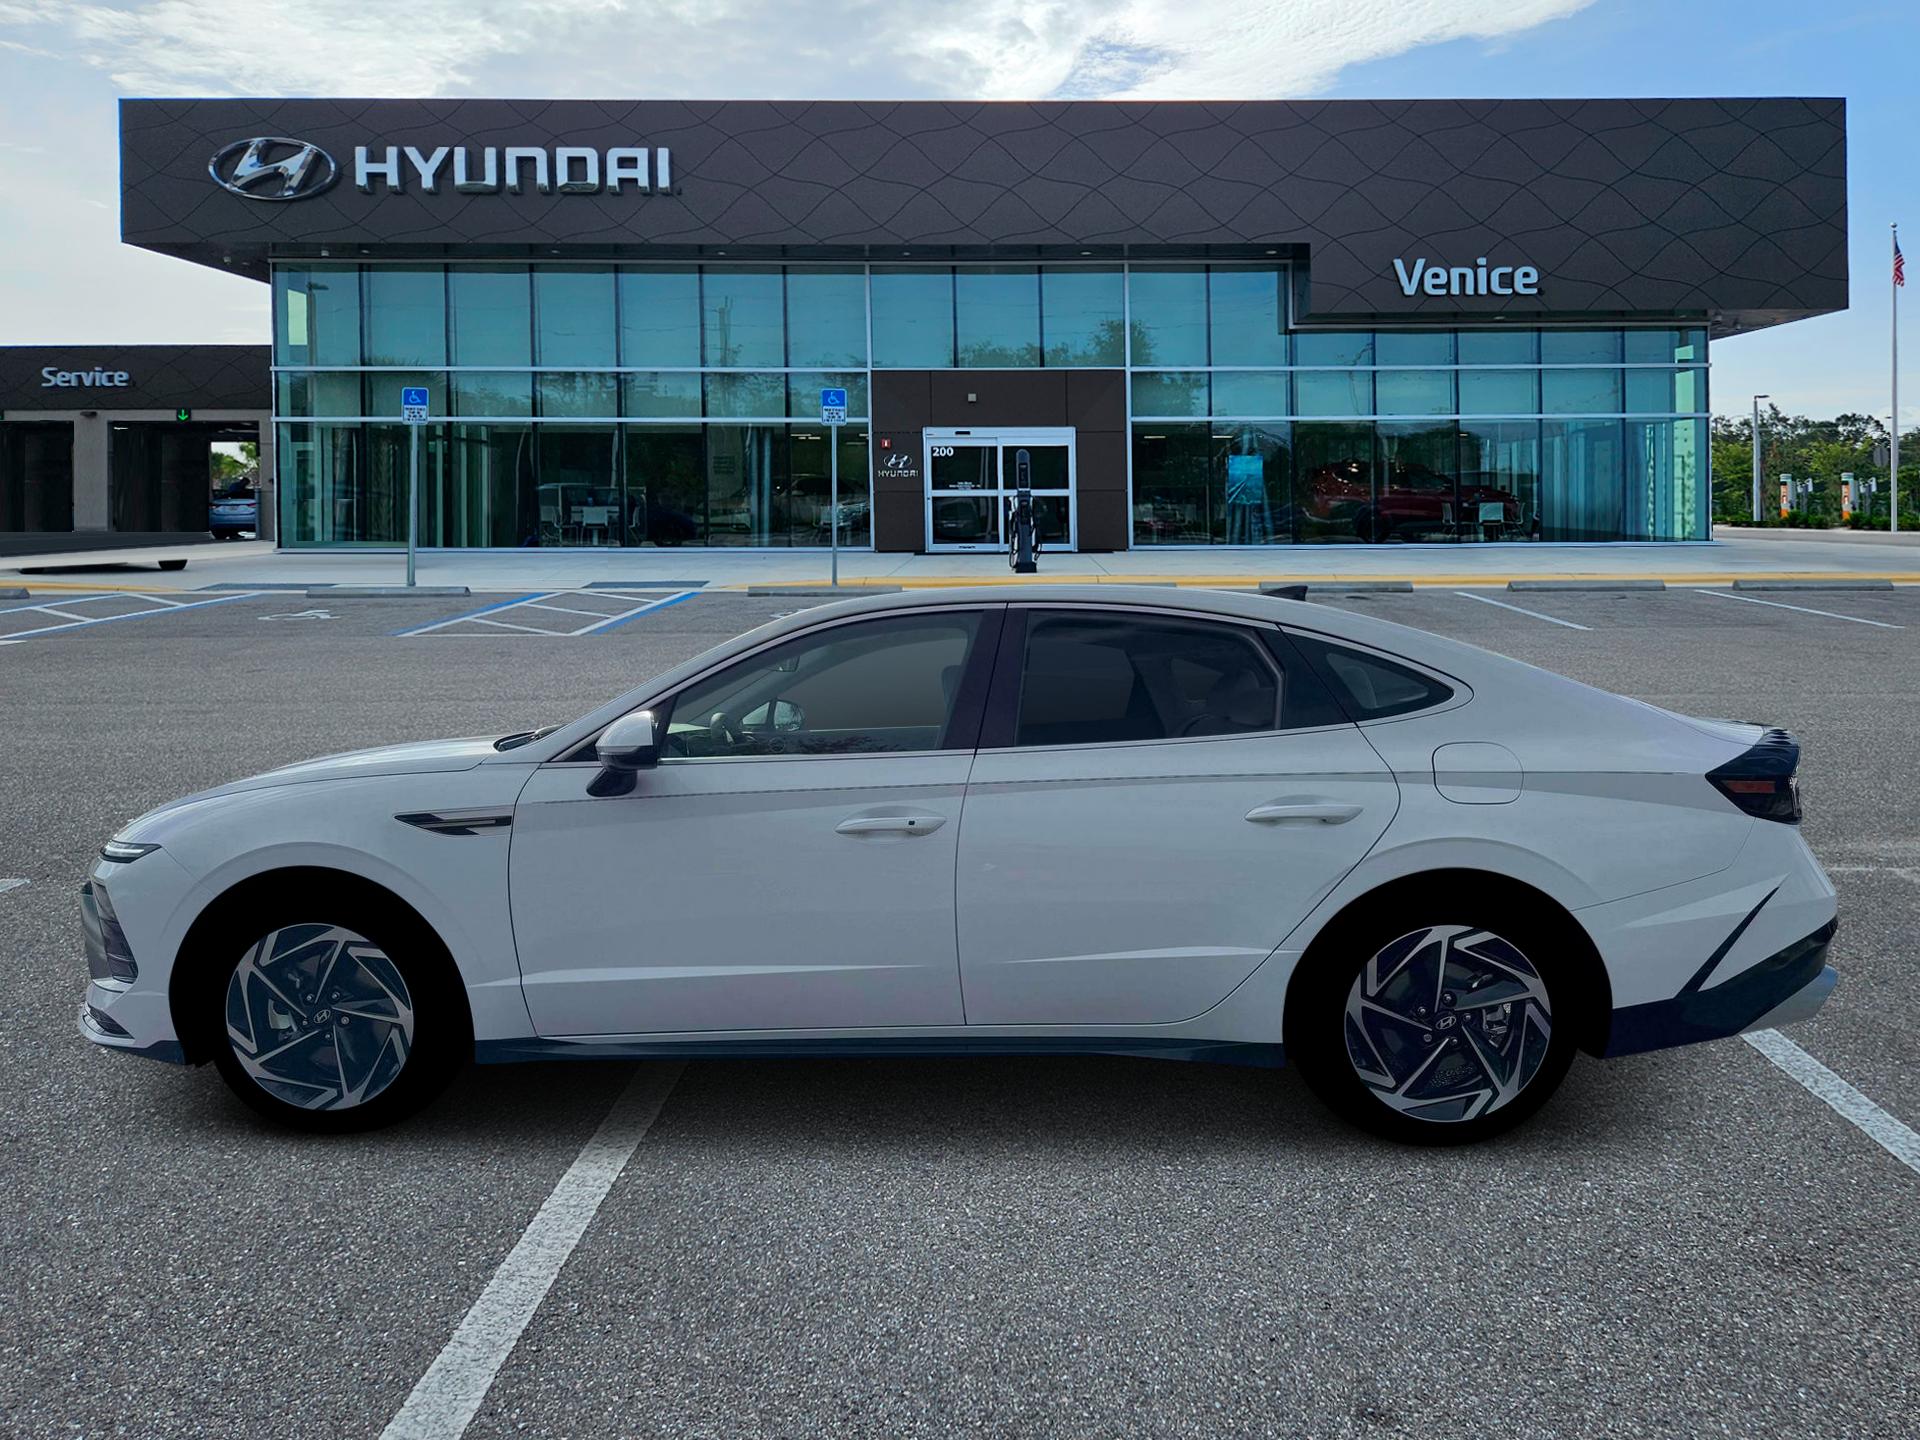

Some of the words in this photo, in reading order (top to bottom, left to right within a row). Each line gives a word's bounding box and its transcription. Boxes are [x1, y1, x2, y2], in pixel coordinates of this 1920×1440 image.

[354, 146, 671, 195] HYUNDAI
[1392, 257, 1539, 295] Venice
[41, 367, 130, 387] Service
[932, 447, 954, 457] 200
[878, 470, 919, 478] HYUNDAI
